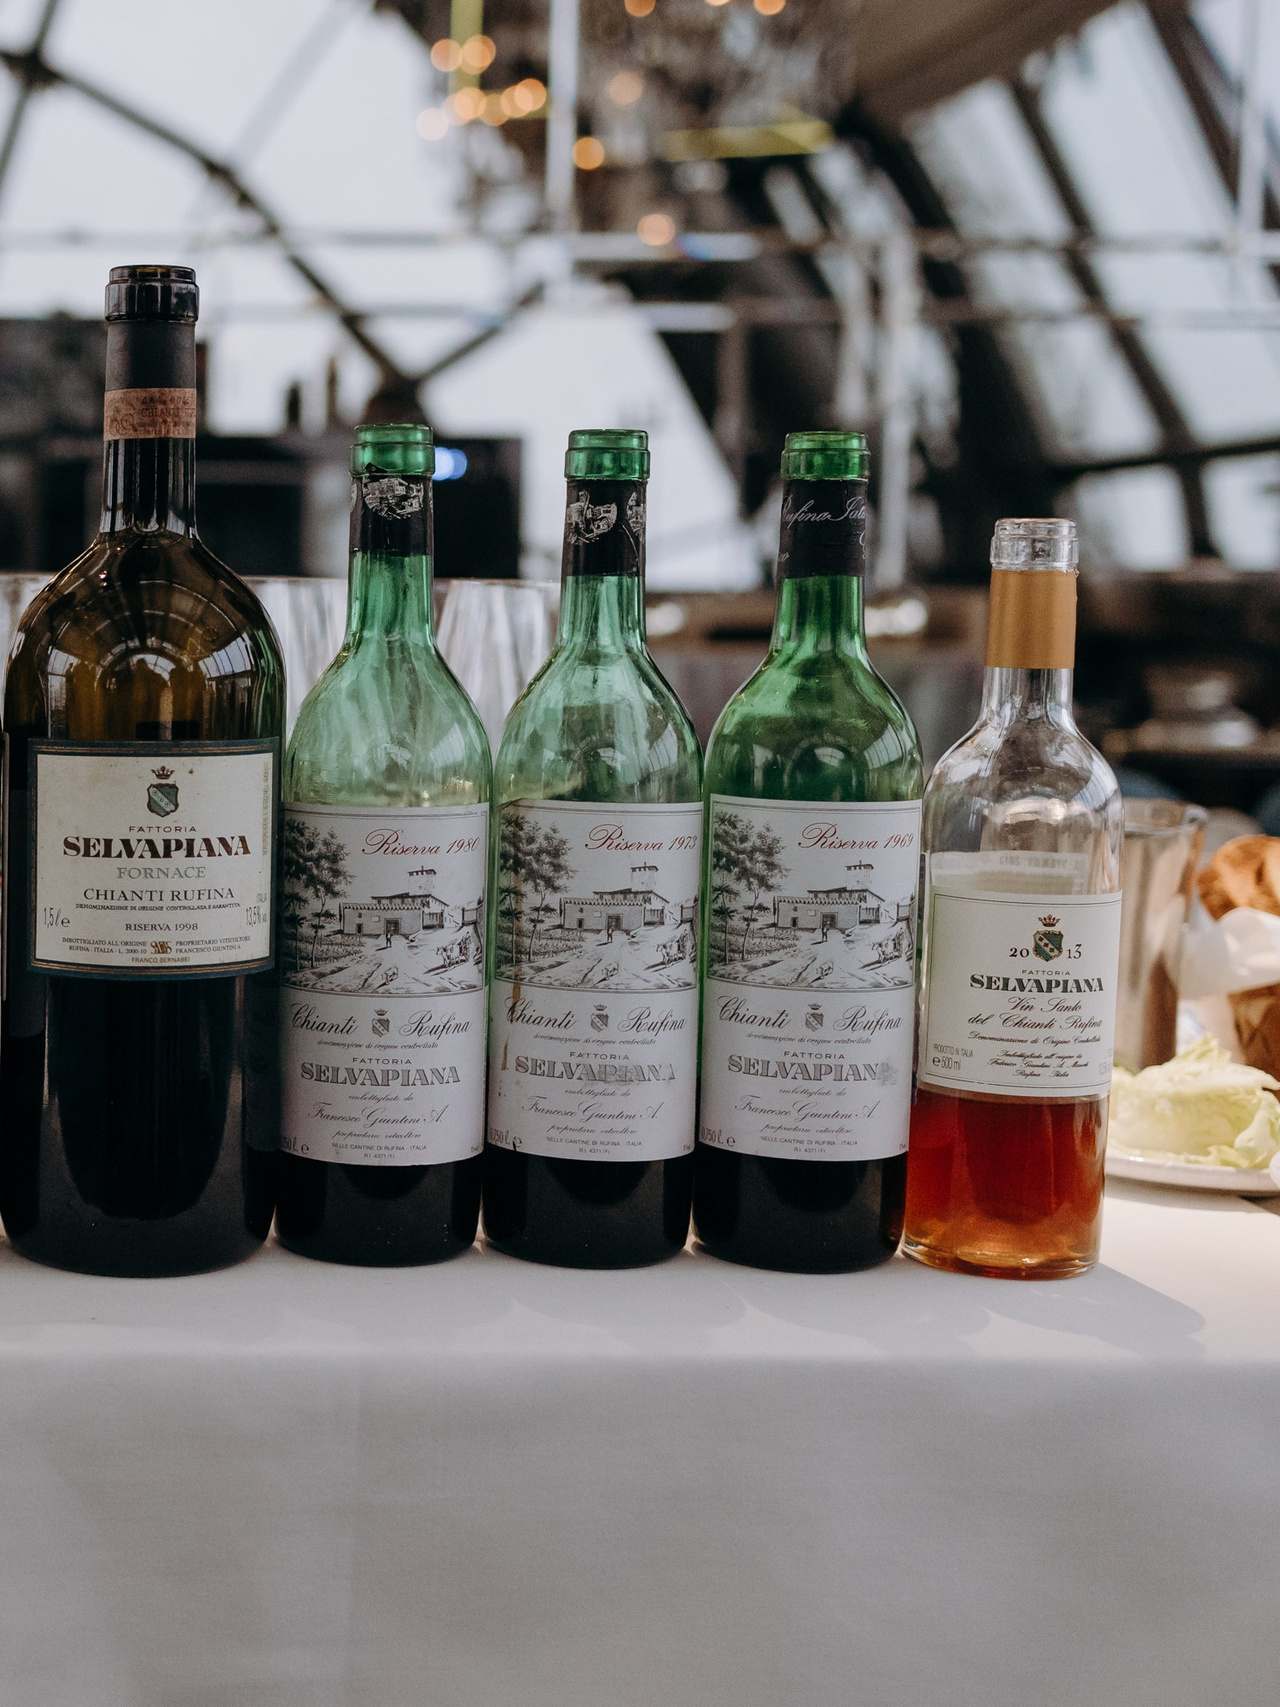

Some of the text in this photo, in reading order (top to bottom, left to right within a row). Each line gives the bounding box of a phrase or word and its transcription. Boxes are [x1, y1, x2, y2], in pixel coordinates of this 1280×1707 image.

[361, 828, 480, 856] Riserva 1980
[584, 823, 698, 851] Riserva 1973
[798, 822, 914, 849] Riserva 1969
[63, 836, 251, 859] SELVAPIANA
[116, 866, 206, 879] FORNACE
[83, 887, 235, 902] CHIANTI RUFINA
[75, 903, 128, 911] DENOMINAZIONE
[125, 923, 198, 931] RISERVA 1998
[62, 937, 107, 946] IMBOTTIGLIATO
[175, 936, 251, 947] PROPRIETARIO VITICOLTORE
[175, 946, 210, 954] FRANCESCO
[159, 956, 191, 964] BERNABEI
[970, 974, 1104, 993] SELVAPIANA
[1008, 997, 1083, 1013] Vin Santo
[290, 1003, 472, 1040] Chianti Rufina
[504, 996, 688, 1037] Chianti Rufina
[717, 995, 904, 1036] Chianti Rufina
[967, 1012, 1103, 1034] del Chianti Rufina
[967, 1030, 1029, 1045] Denominazione
[1042, 1036, 1071, 1048] Origine
[570, 1051, 630, 1060] FATTORIA
[783, 1051, 845, 1059] FATTORIA
[933, 1043, 954, 1056] PRODOTTO
[960, 1048, 974, 1058] ITALIA
[352, 1057, 412, 1065] FATTORIA
[728, 1054, 890, 1082] SELVAPIAN
[941, 1056, 954, 1070] 500
[301, 1061, 460, 1087] SELVAPIANA
[307, 1102, 421, 1127] Francesco Giuntini
[522, 1095, 576, 1117] Francesco
[578, 1101, 637, 1123] Giuntini
[734, 1095, 791, 1117] Francesco
[792, 1101, 853, 1122] Giuntini
